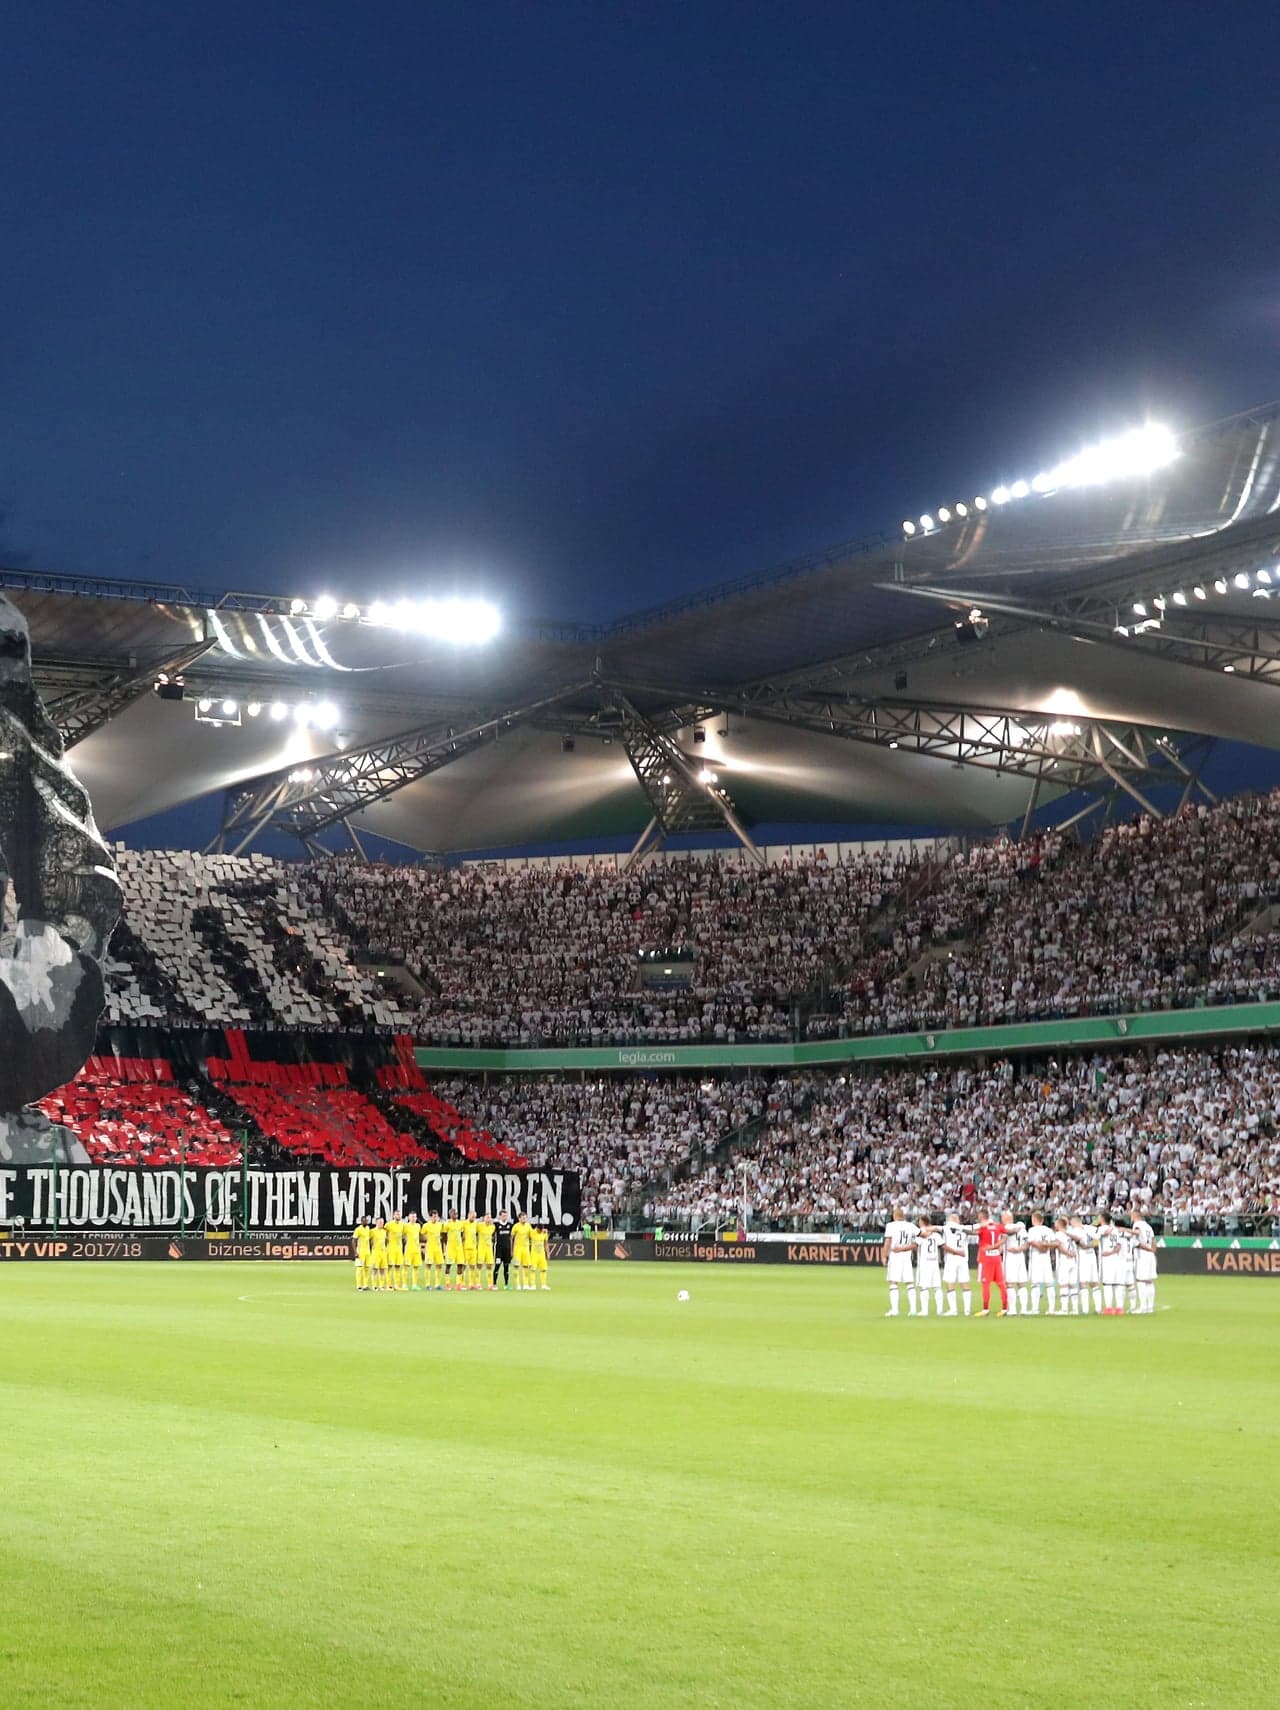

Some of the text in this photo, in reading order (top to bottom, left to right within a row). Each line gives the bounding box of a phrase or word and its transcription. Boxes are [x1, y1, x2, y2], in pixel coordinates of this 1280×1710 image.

[619, 1051, 675, 1064] legia.com
[27, 1168, 197, 1226] THOUSANDS
[205, 1170, 241, 1225] OF
[247, 1170, 320, 1226] THEM
[330, 1171, 411, 1226] WERE
[421, 1172, 574, 1226] CHILDREN.
[33, 1242, 67, 1258] VIP
[72, 1243, 142, 1257] 2017/18
[787, 1245, 862, 1262] KARNETY
